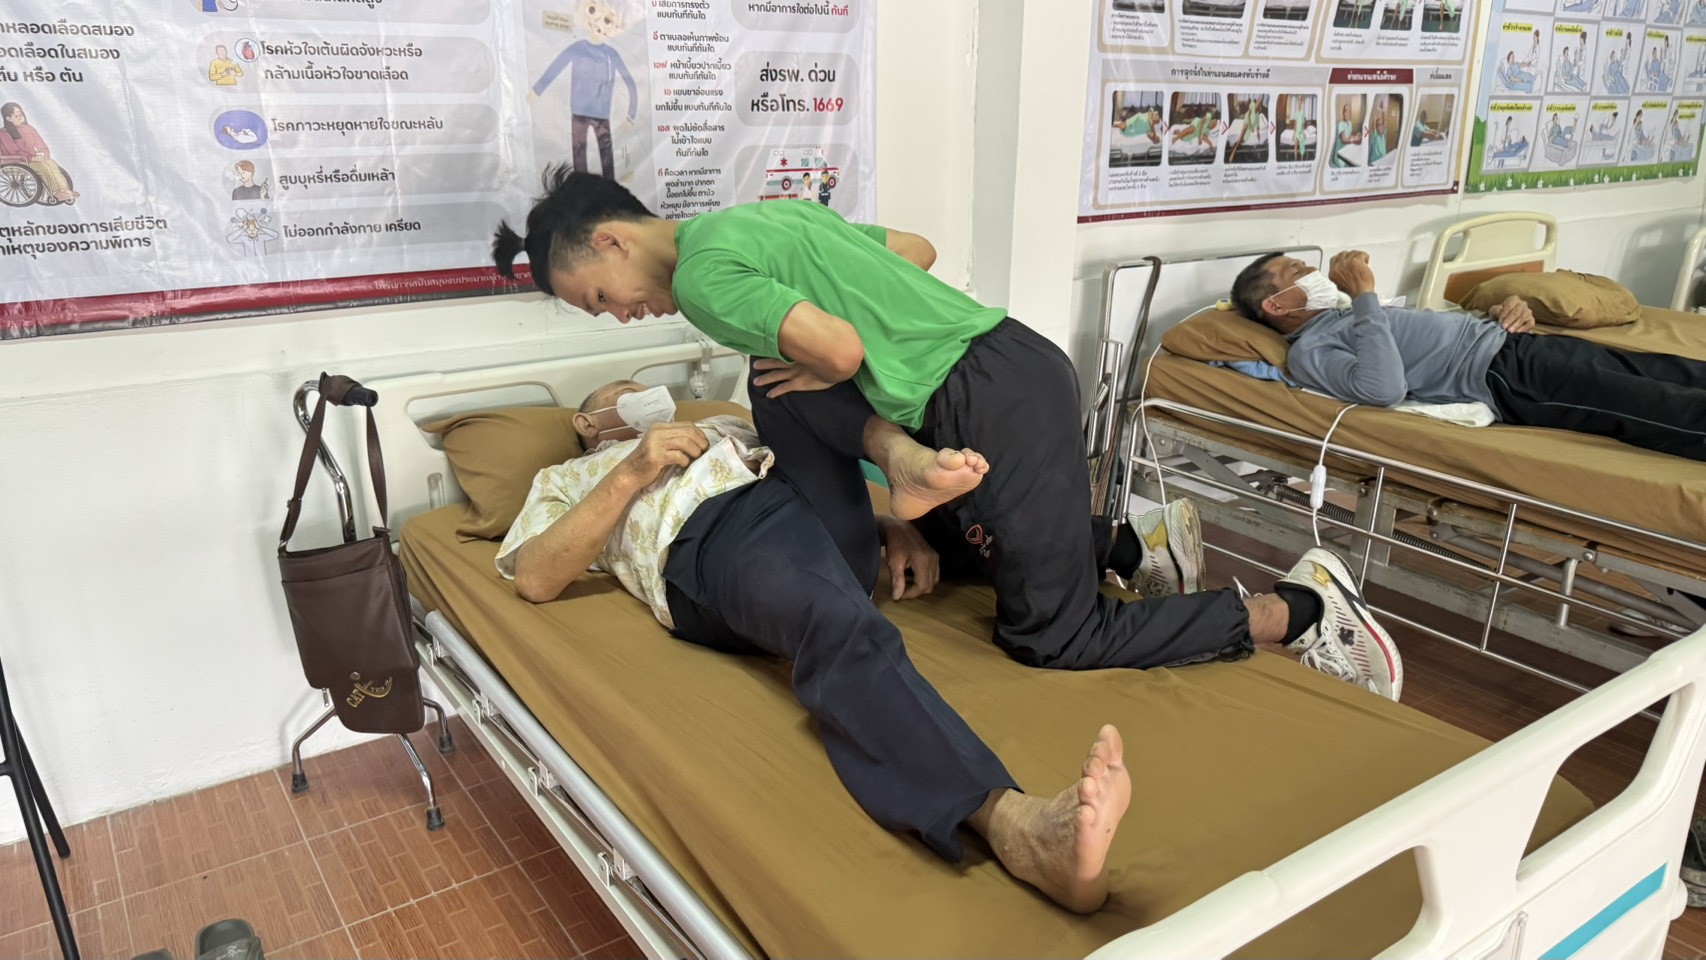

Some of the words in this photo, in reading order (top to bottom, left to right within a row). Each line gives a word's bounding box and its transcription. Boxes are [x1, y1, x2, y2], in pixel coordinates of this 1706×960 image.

[657, 9, 706, 19] แบบทันทีทันใด
[748, 1, 830, 15] หากมีอาการใดต่อไปนี้
[831, 5, 849, 16] ทันที
[660, 32, 729, 42] ตาเบลอเห็นภาพซ้อน
[260, 40, 423, 57] โรคหัวใจเต้นผิดจังหวะหรือ
[667, 43, 715, 53] แบบทันทีทันใด
[264, 61, 409, 80] กล้ามเนื้อหัวใจขาดเลือด
[654, 61, 667, 69] เอฟ
[670, 58, 731, 70] หน้าเบี้ยวปากเบี้ยว
[23, 66, 56, 82] หรือ
[59, 67, 84, 82] ตัน
[669, 72, 716, 81] แบบทันทีทันใด
[759, 61, 804, 83] ส่งรพ.
[808, 62, 836, 82] ด่วน
[664, 88, 672, 96] เอ
[673, 87, 724, 96] แขนขาอ่อนแรง
[655, 99, 683, 111] ยกไม่ขึ้น
[684, 102, 732, 111] แบบทันทีทันใด
[751, 92, 810, 113] หรือโทร.
[813, 97, 844, 112] 1669
[271, 116, 443, 136] โรคภาวะหยุดหายใจขณะหลับ
[673, 120, 725, 134] พูดไม่ชัดสื่อสาร
[676, 148, 708, 157] ทันทีทันใด
[279, 164, 395, 190] สูบบุหรี่หรือดื่มเหล้า
[283, 222, 382, 239] ไม่ออกกำลังกาย
[385, 218, 421, 232] เครียด
[346, 689, 365, 708] CAT
